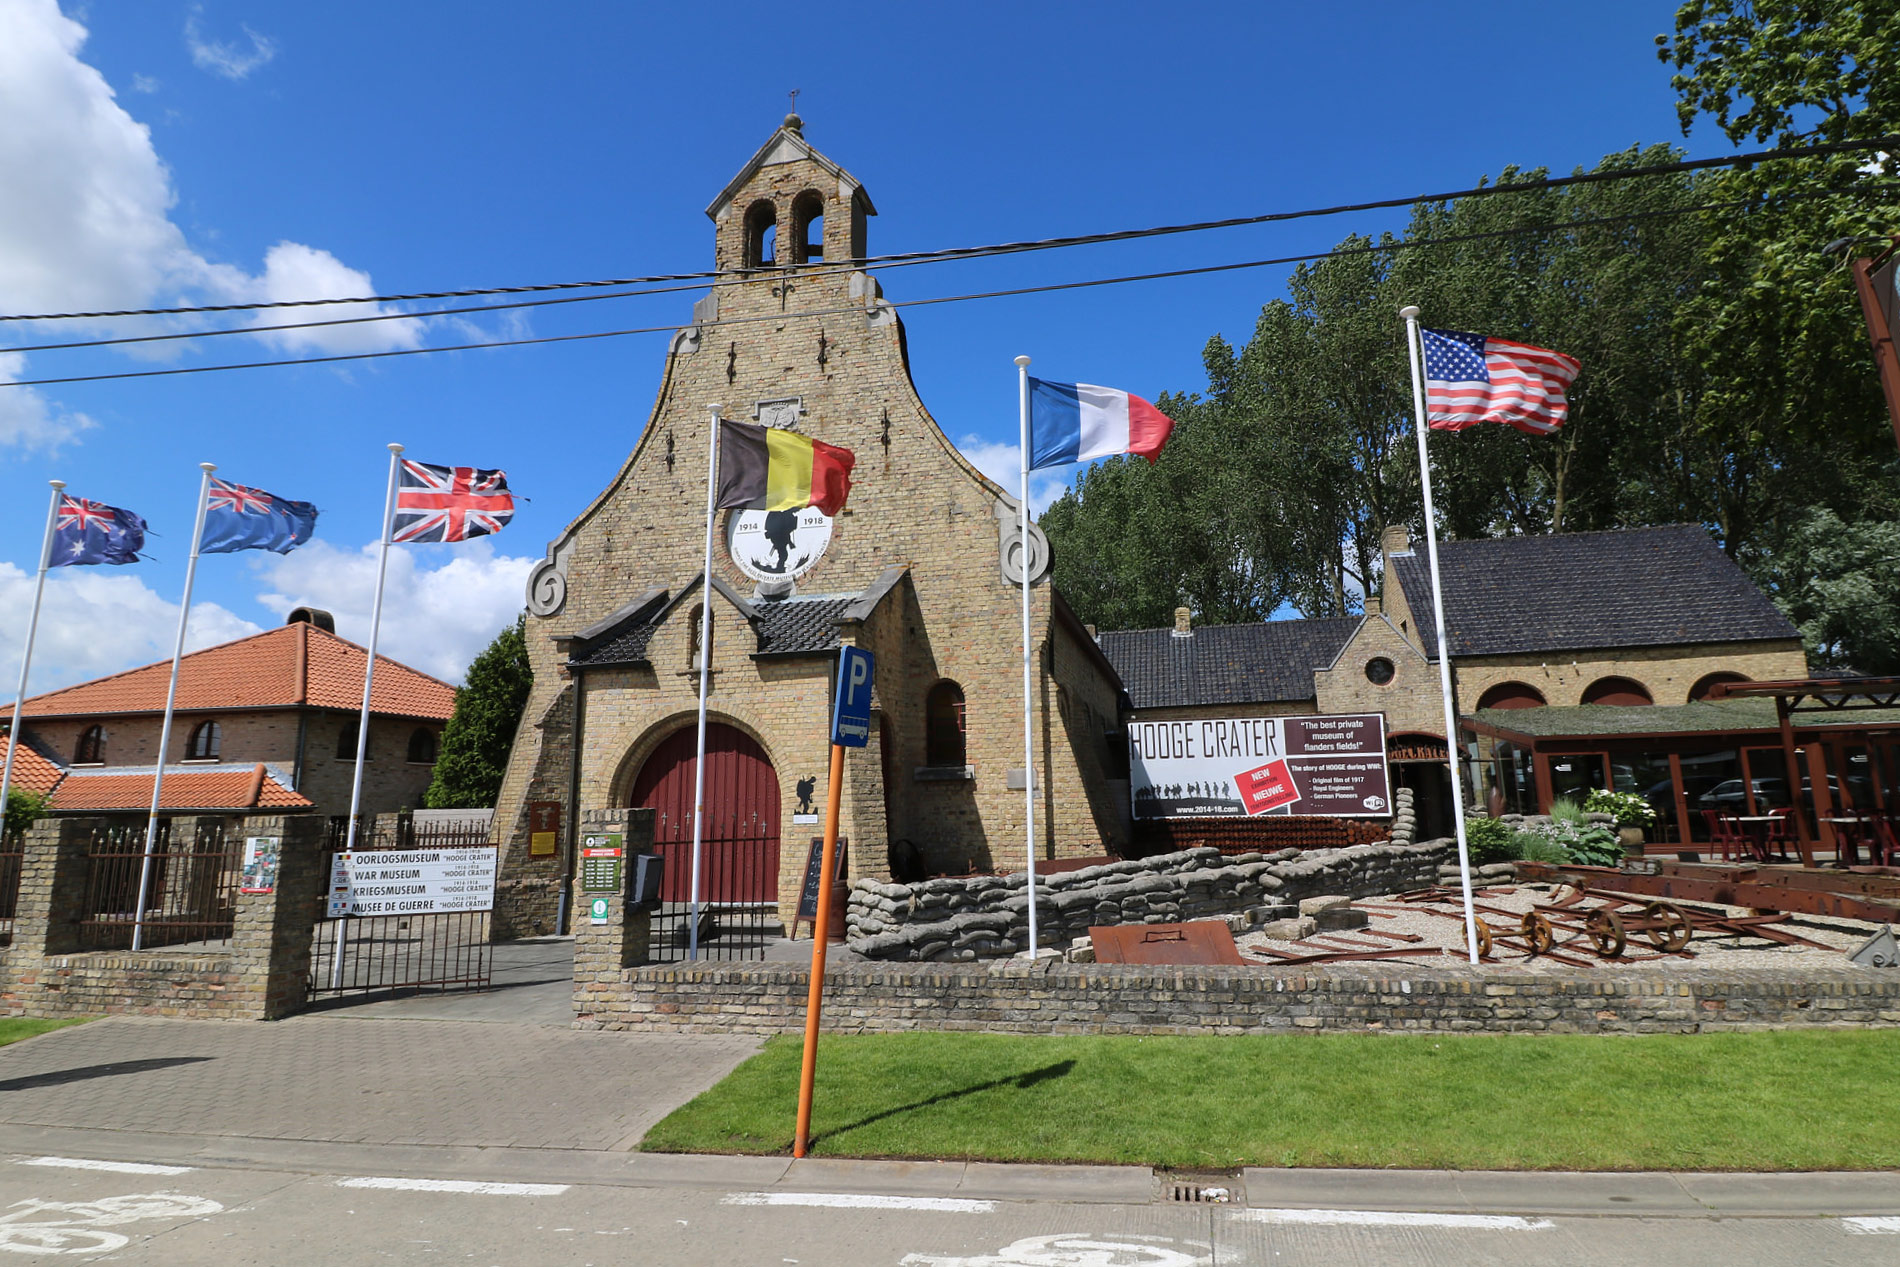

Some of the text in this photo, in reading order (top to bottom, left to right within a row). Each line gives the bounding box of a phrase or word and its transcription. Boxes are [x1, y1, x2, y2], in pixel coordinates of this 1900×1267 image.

[804, 517, 823, 525] 1918
[739, 523, 758, 531] 1914
[848, 655, 867, 706] P
[1320, 720, 1336, 729] best
[1338, 720, 1364, 730] private
[1131, 720, 1277, 760] HOOGE CRATER
[1312, 732, 1344, 740] museum
[1304, 743, 1334, 751] flanders
[1251, 768, 1270, 781] NEW
[1252, 784, 1285, 802] NIEUWE
[356, 853, 440, 864] OORLOGSMUSEUM
[355, 870, 420, 880] WAR MUSEUM
[353, 885, 426, 896] KRIEGSMUSEUM
[351, 900, 434, 912] MUSEE DE GUERRE
